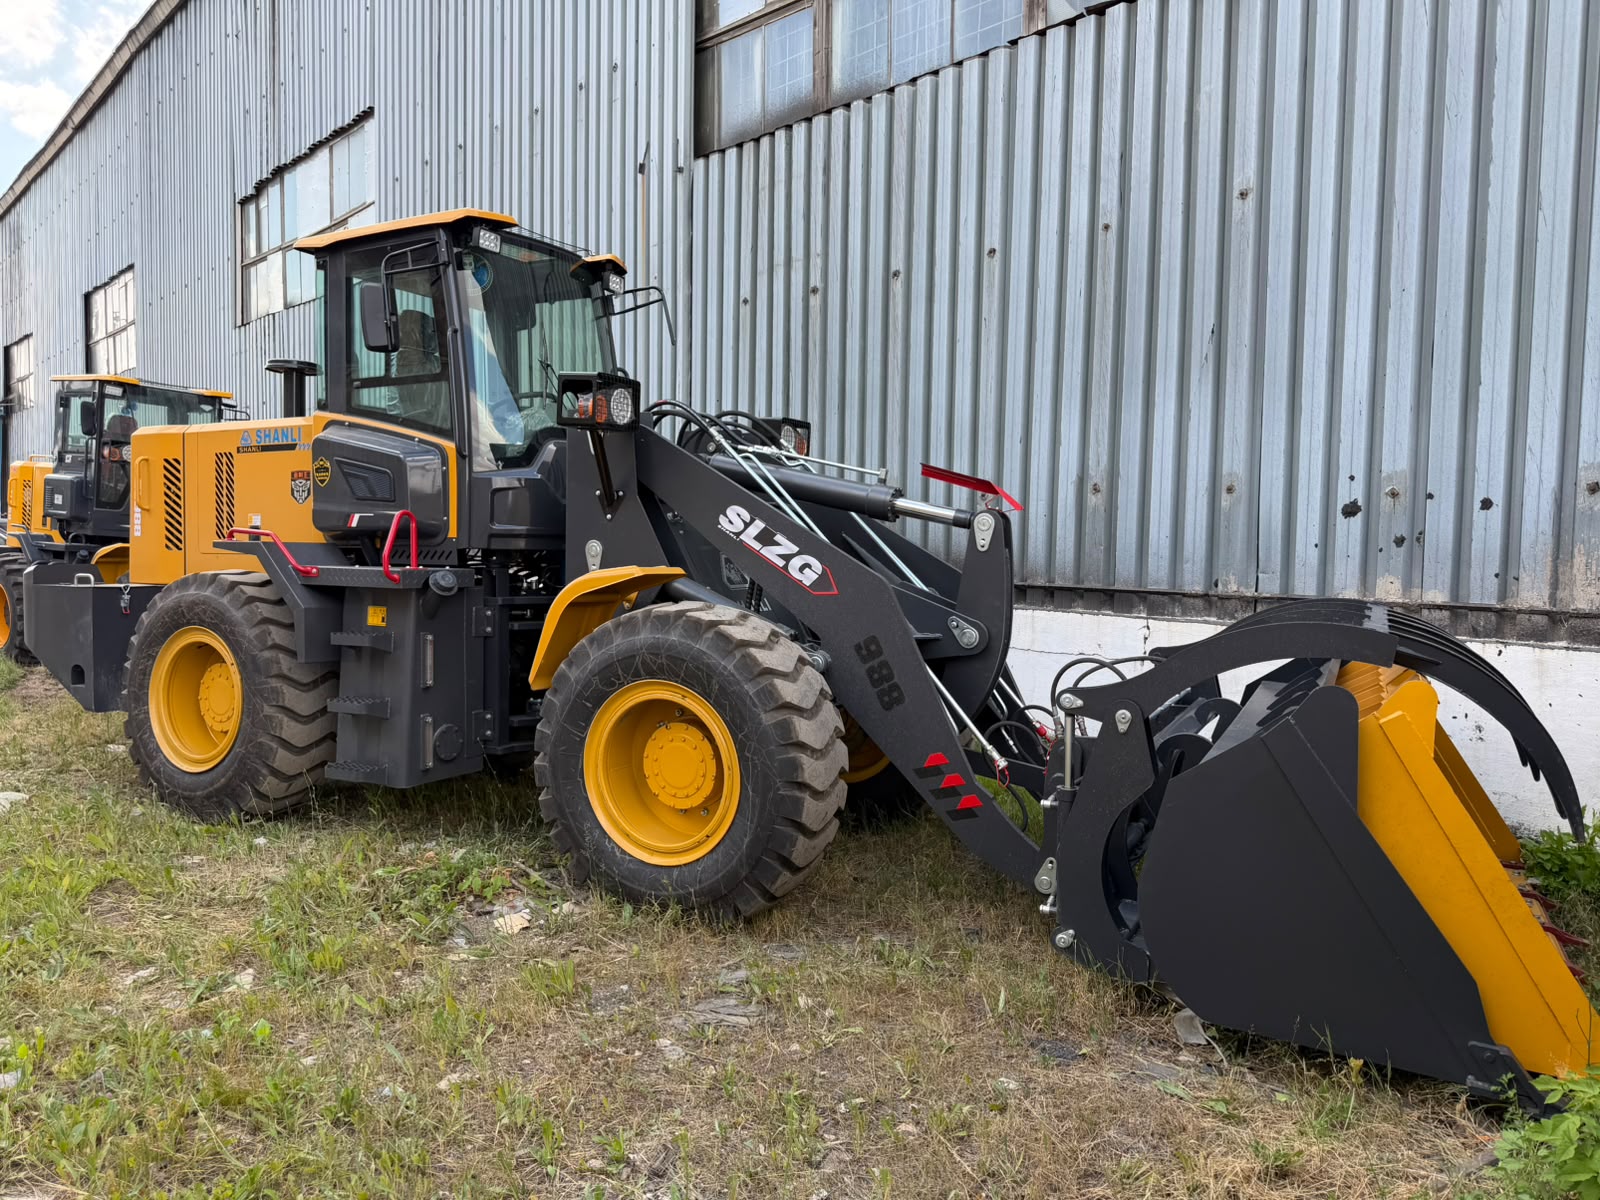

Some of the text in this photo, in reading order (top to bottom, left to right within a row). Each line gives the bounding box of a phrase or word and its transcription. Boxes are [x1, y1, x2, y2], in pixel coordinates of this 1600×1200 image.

[239, 445, 262, 453] SHANLI
[256, 426, 302, 444] SHANLI
[718, 505, 823, 587] SLZG
[854, 635, 906, 711] 988
